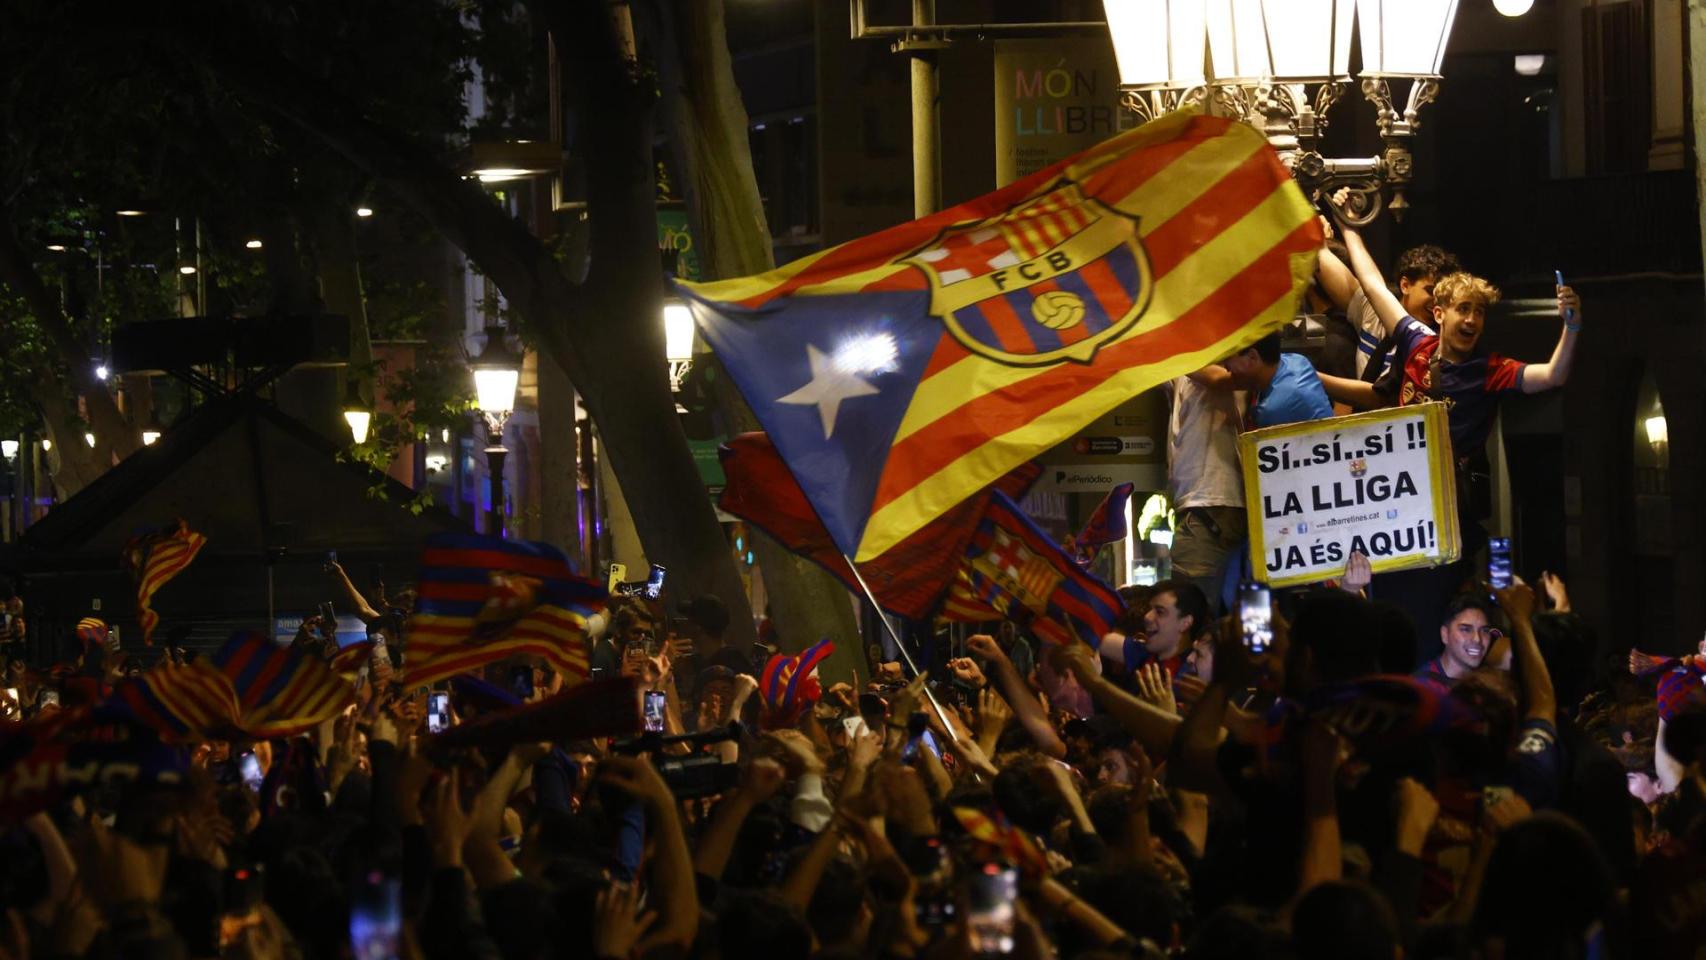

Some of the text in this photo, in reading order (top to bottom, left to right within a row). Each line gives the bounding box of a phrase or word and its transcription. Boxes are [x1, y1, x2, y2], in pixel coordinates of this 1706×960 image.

[1015, 57, 1097, 99] MÓN
[1264, 471, 1418, 519] LA LLIGA
[1266, 520, 1435, 572] JA ÉS AQUÍ!
